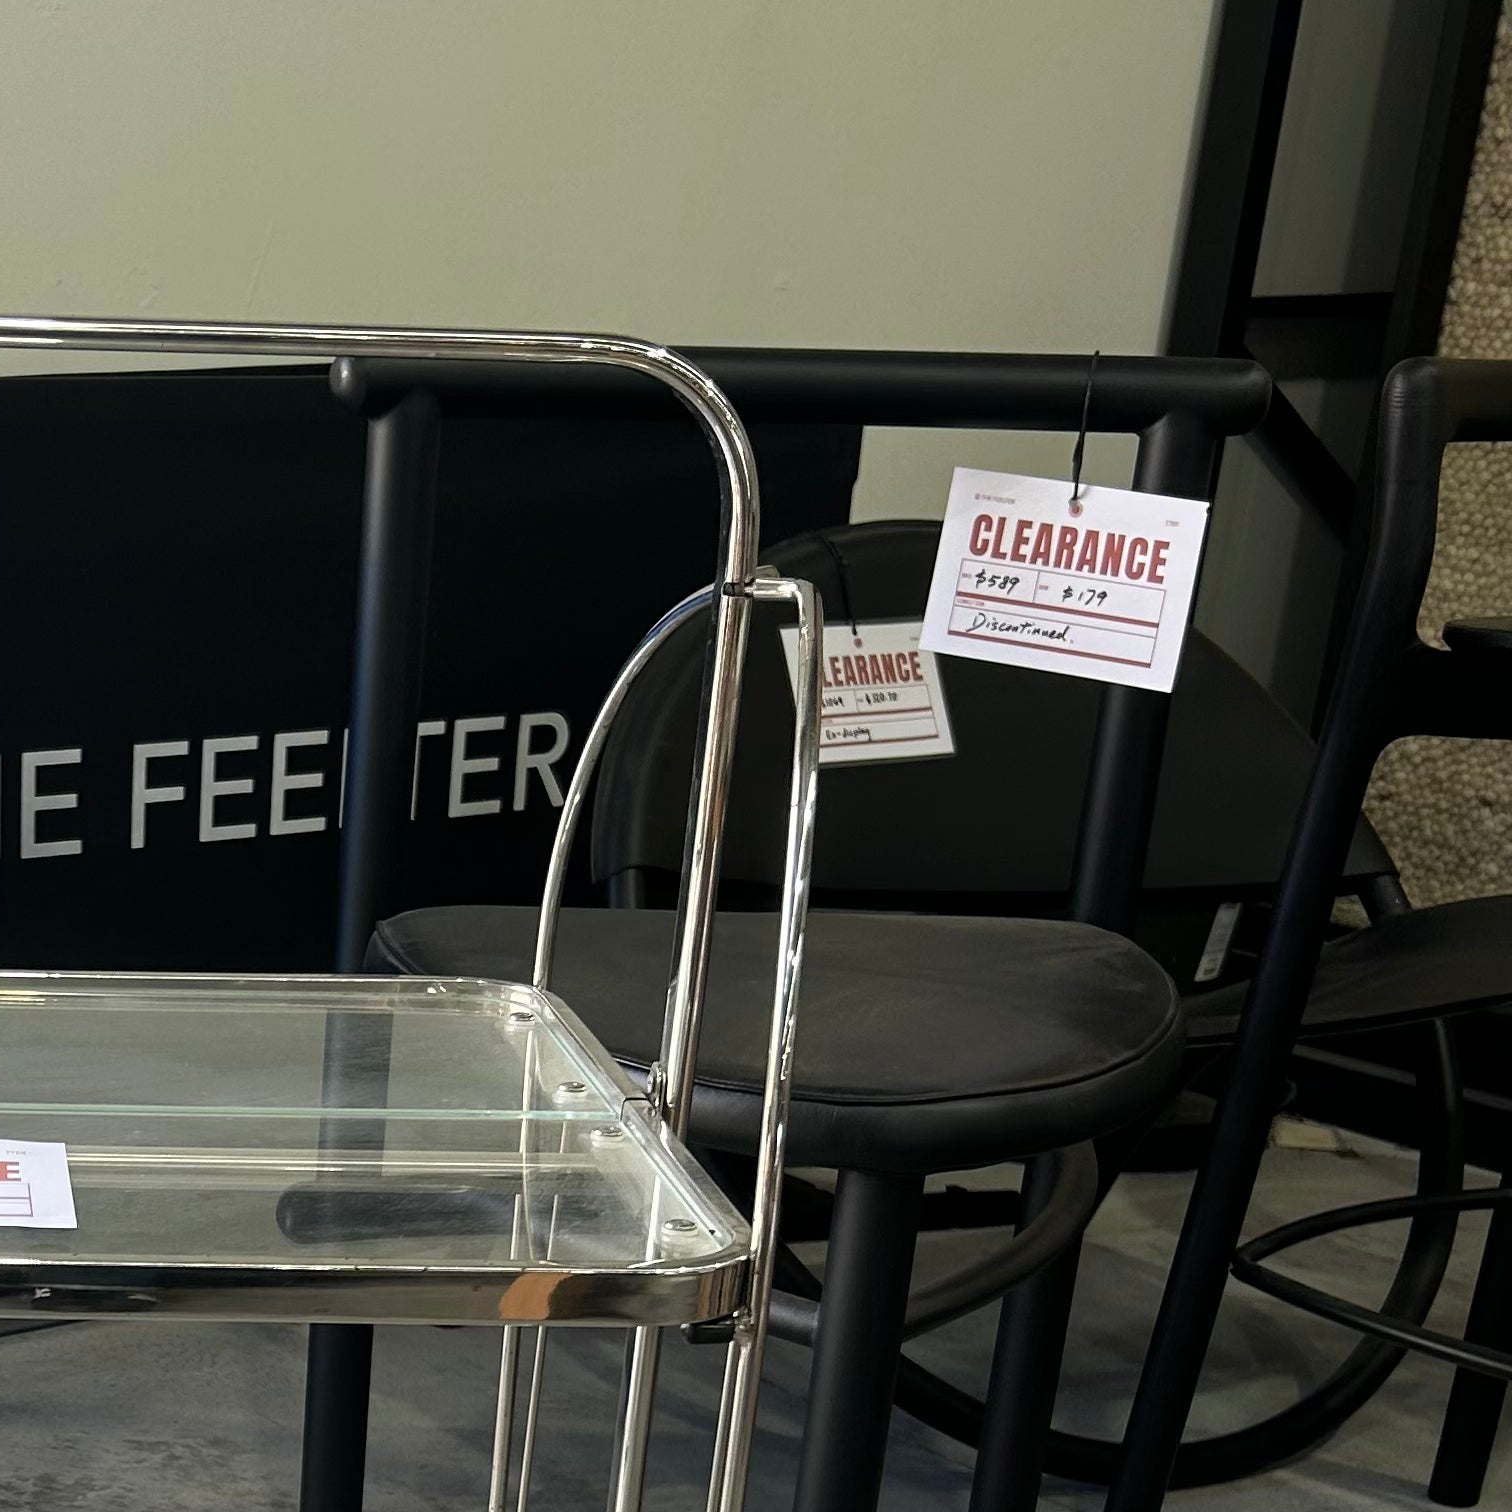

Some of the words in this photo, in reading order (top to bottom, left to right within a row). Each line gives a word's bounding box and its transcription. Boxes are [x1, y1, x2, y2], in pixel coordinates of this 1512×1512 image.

[968, 513, 1170, 585] CLEARANCE
[974, 568, 1020, 595] $589
[1061, 587, 1108, 607] $179
[822, 651, 924, 688] LEARANCE
[130, 711, 570, 849] FEETER
